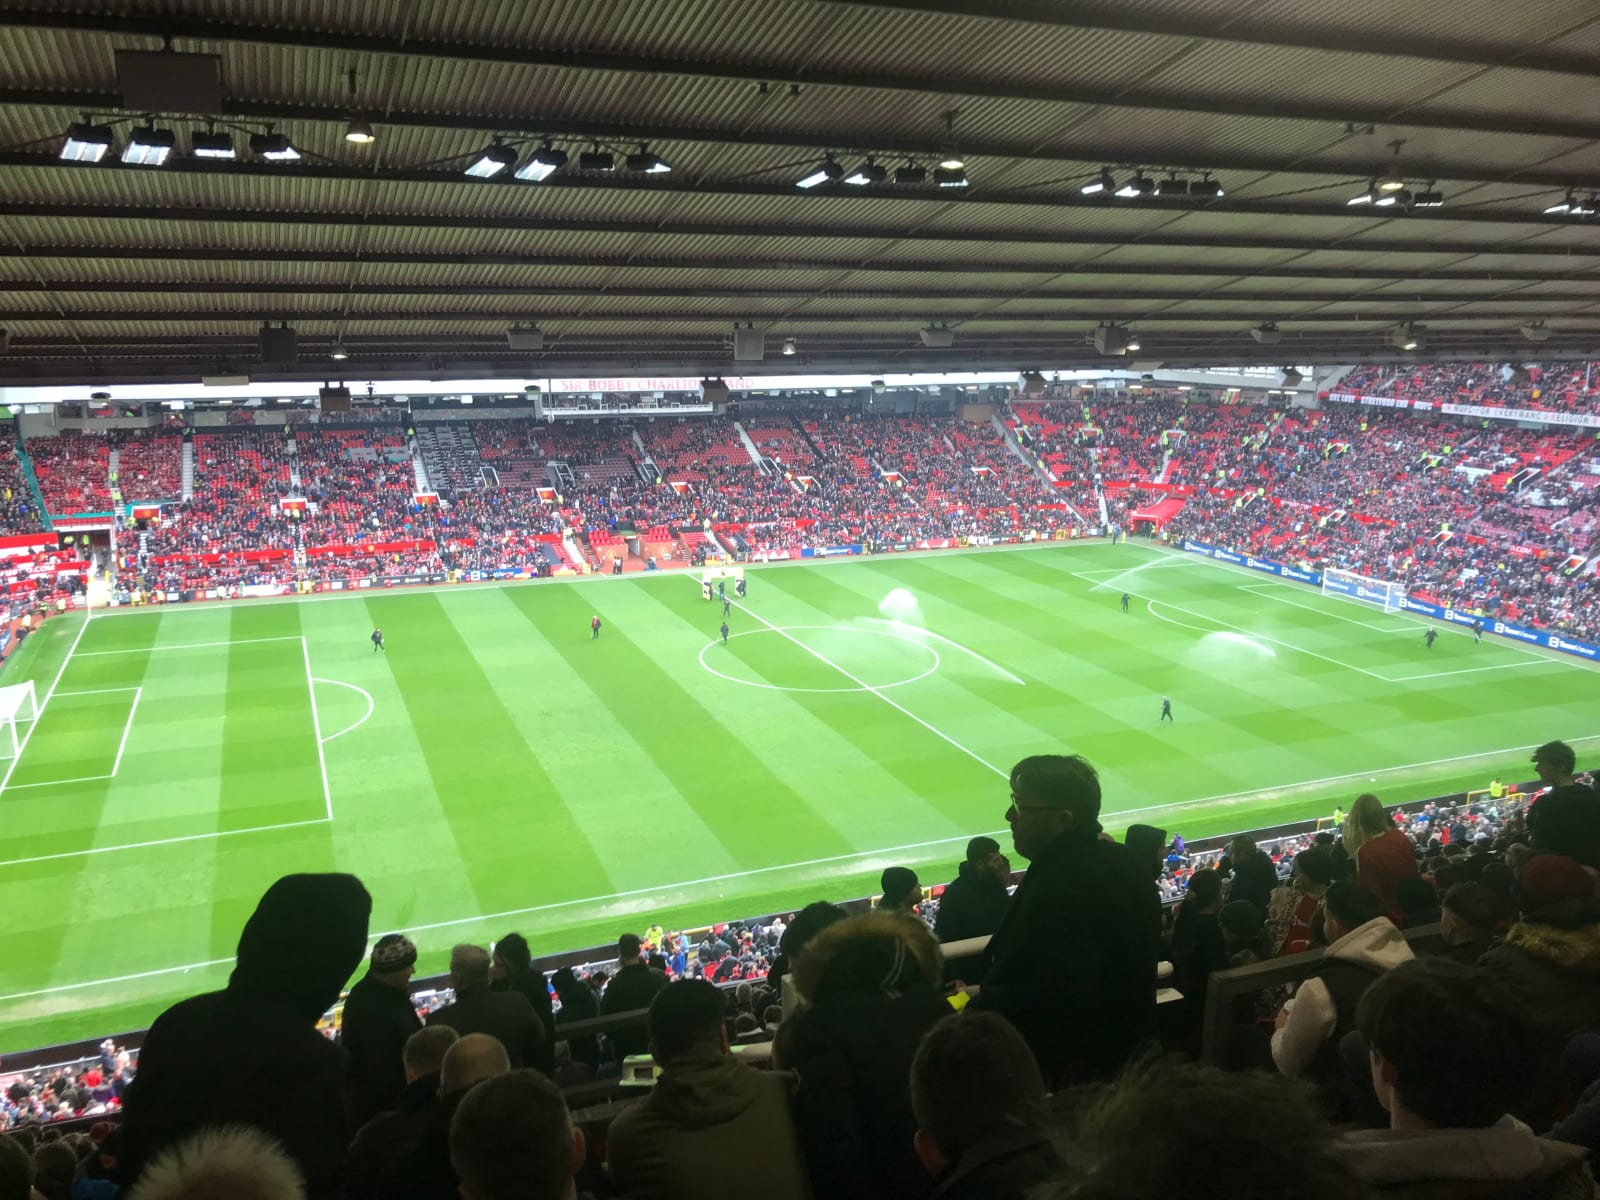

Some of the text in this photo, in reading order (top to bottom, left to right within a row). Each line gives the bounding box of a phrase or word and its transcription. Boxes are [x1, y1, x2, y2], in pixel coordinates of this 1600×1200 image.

[561, 380, 582, 391] SIR
[588, 379, 631, 391] BOBBY
[638, 379, 697, 390] CHARLTO
[1551, 414, 1590, 424] RELIGION
